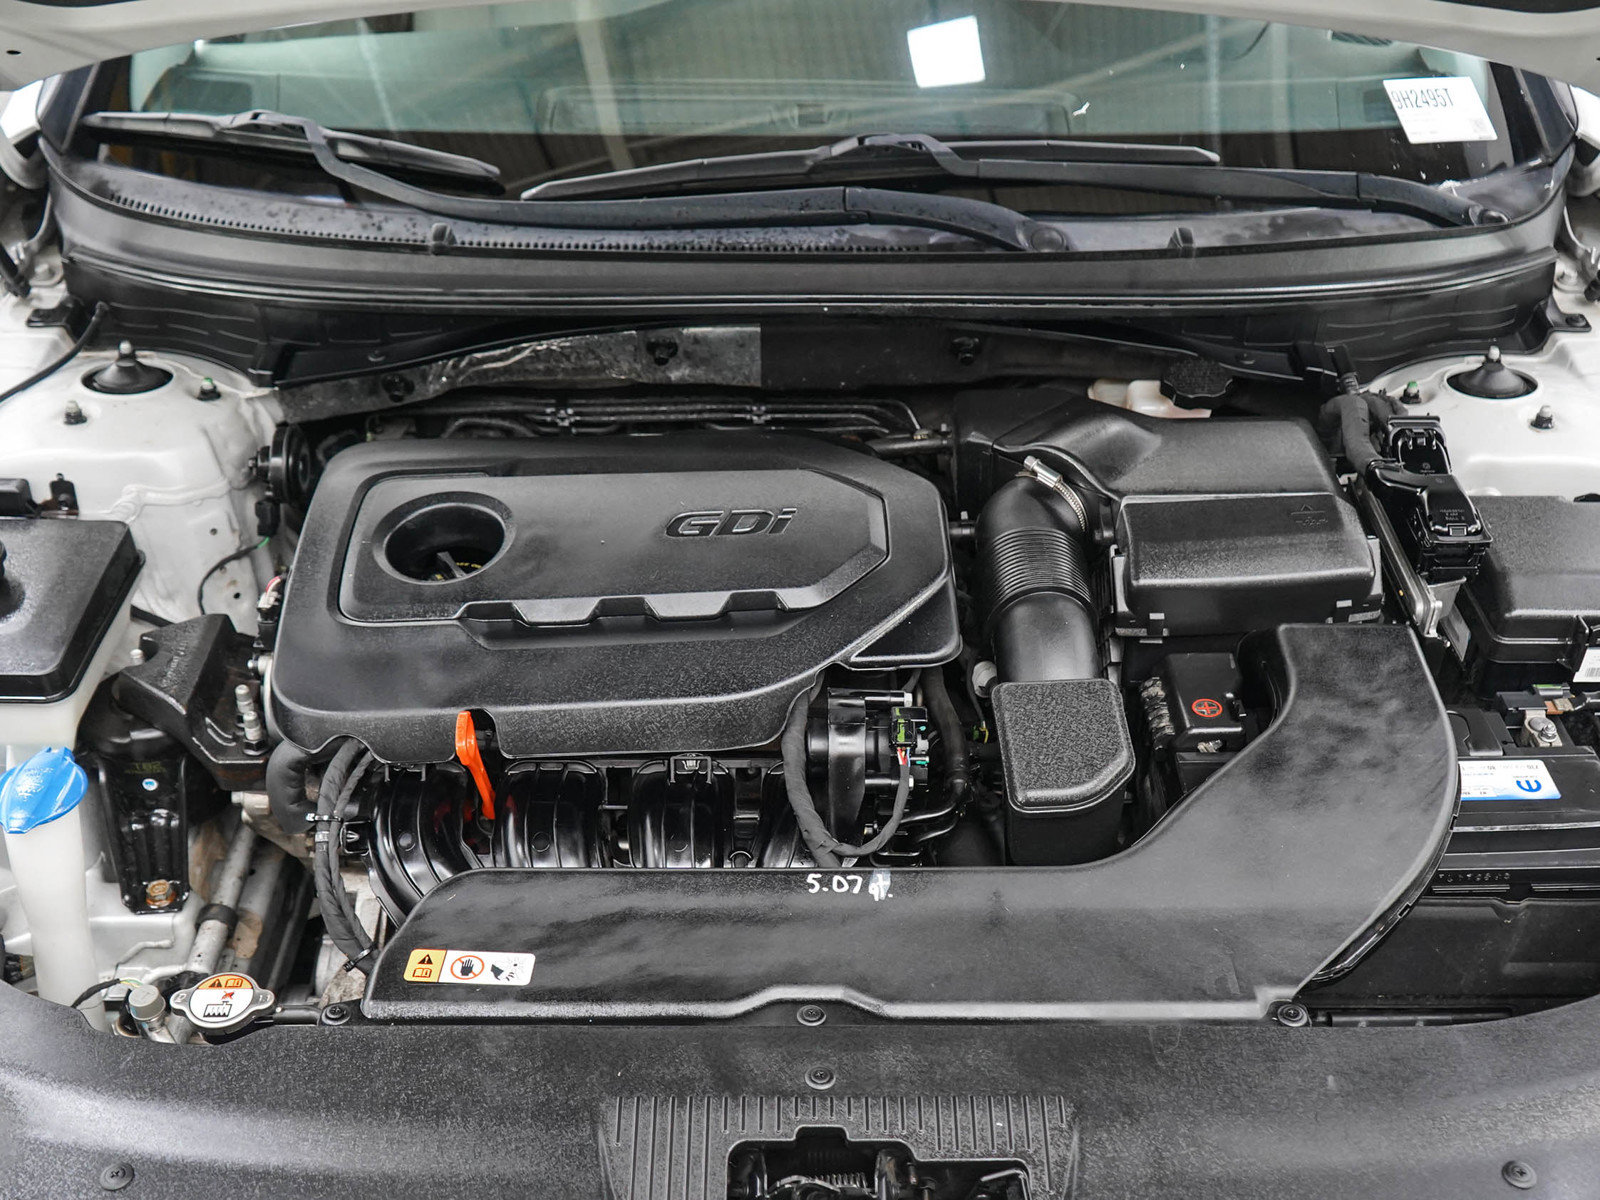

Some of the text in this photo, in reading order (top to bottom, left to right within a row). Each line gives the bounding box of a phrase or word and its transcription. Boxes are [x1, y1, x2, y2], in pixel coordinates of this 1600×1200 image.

[1391, 87, 1454, 110] 9H2495T
[665, 507, 797, 538] GDi
[806, 873, 863, 894] 5.07
